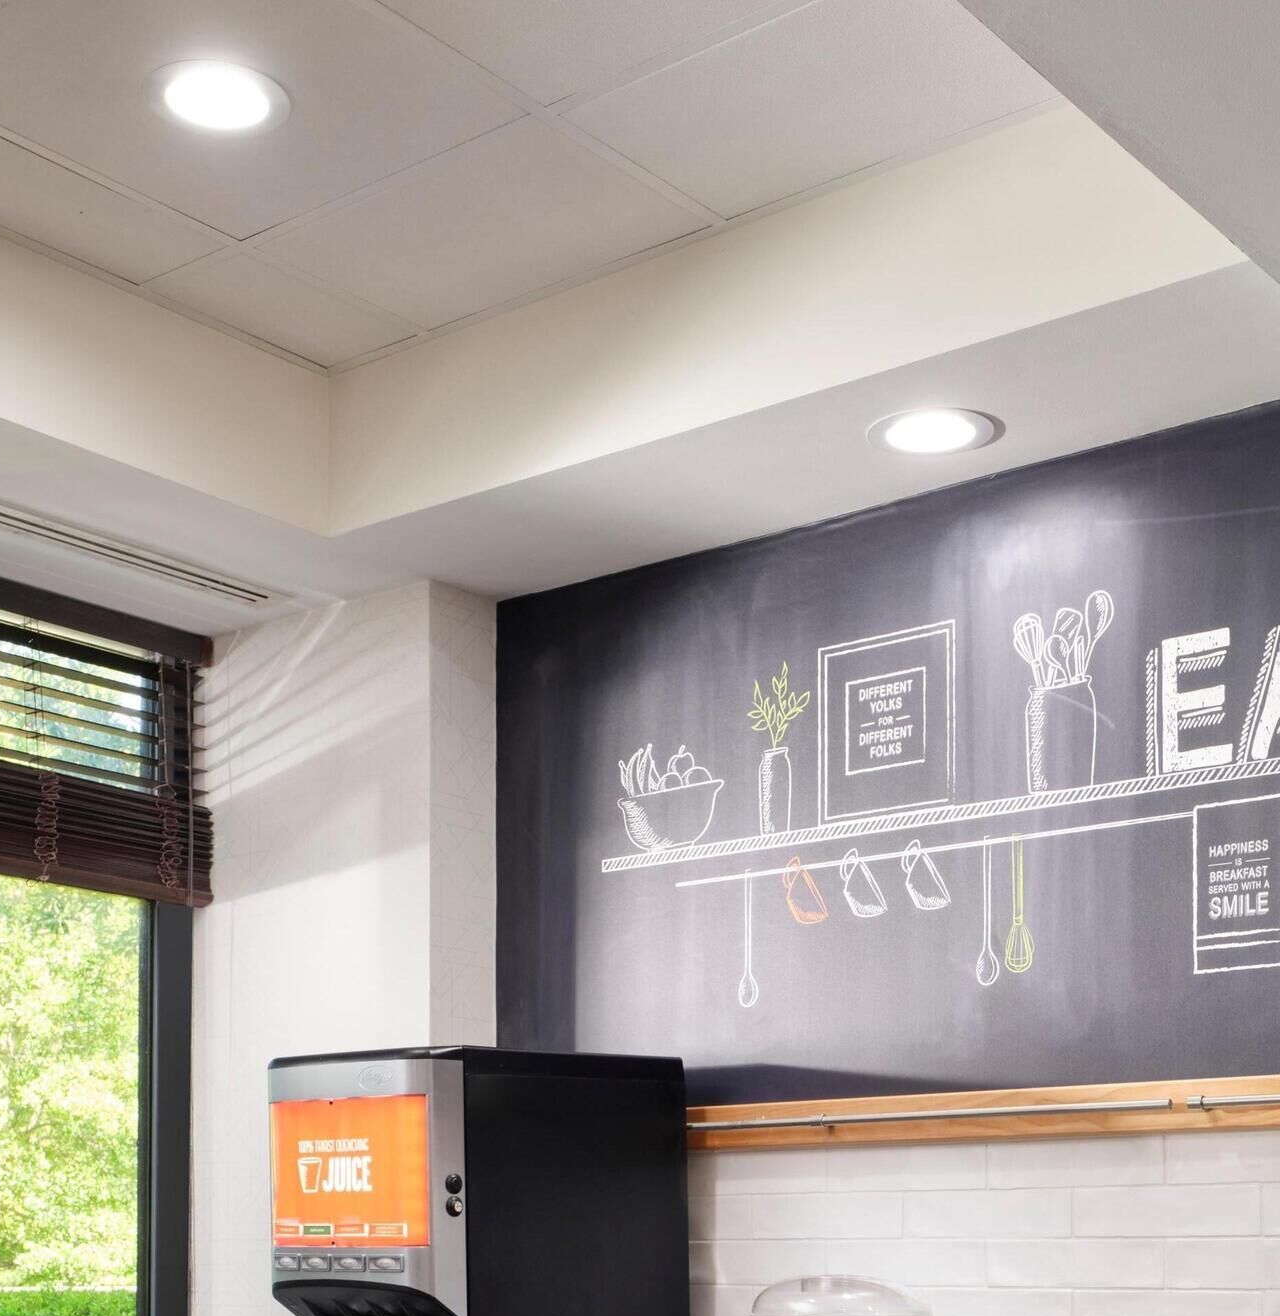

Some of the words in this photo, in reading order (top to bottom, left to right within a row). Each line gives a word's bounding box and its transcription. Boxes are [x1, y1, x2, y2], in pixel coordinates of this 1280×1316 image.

[858, 680, 913, 702] DIFFERENT
[869, 697, 903, 714] YOLKS
[878, 715, 894, 727] FOR
[858, 725, 914, 747] DIFFERENT
[869, 742, 902, 759] FOLKS
[1208, 839, 1269, 858] HAPPINESS
[1234, 858, 1243, 866] IS
[1208, 865, 1269, 883] BREAKFAST
[1208, 883, 1239, 895] SERVED
[1241, 880, 1262, 891] WITH
[1263, 879, 1271, 889] A
[1208, 891, 1270, 920] SMILE
[322, 1155, 373, 1192] JUICE
